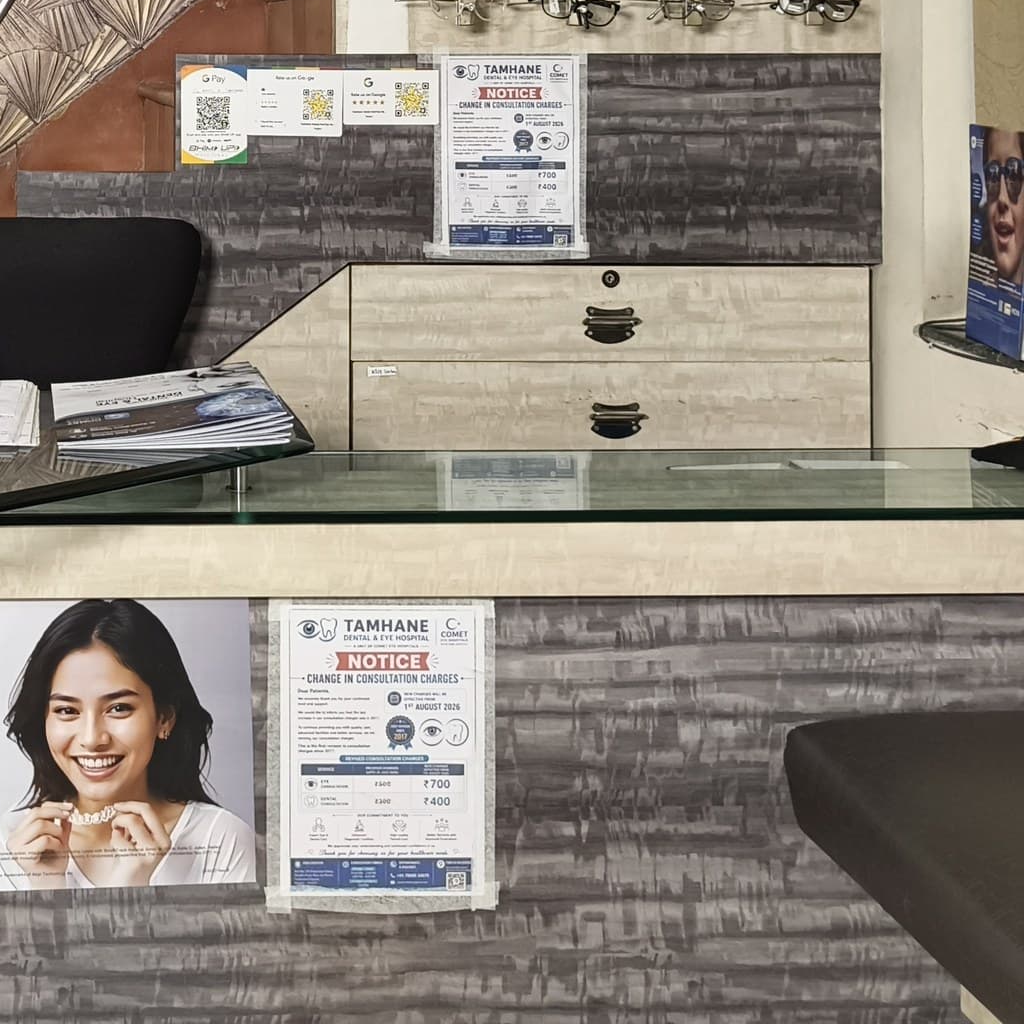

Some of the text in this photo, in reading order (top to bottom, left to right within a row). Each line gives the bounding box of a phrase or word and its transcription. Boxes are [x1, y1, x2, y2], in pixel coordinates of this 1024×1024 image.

[484, 65, 542, 74] TAMHANE
[211, 75, 226, 84] Pay
[486, 88, 537, 98] NOTICE
[459, 101, 563, 109] CHANGE IN CONSULTATION CHARGES
[344, 619, 429, 633] TAMHANE
[344, 634, 370, 642] DENTAL
[380, 634, 393, 642] EYE
[395, 634, 429, 642] HOSPITAL
[348, 653, 422, 669] NOTICE
[306, 673, 459, 684] CHANGE IN CONSULTATION CHARGES
[416, 703, 441, 711] AUGUST
[444, 703, 461, 711] 2026
[423, 779, 451, 789] ₹700
[423, 796, 451, 806] ₹400
